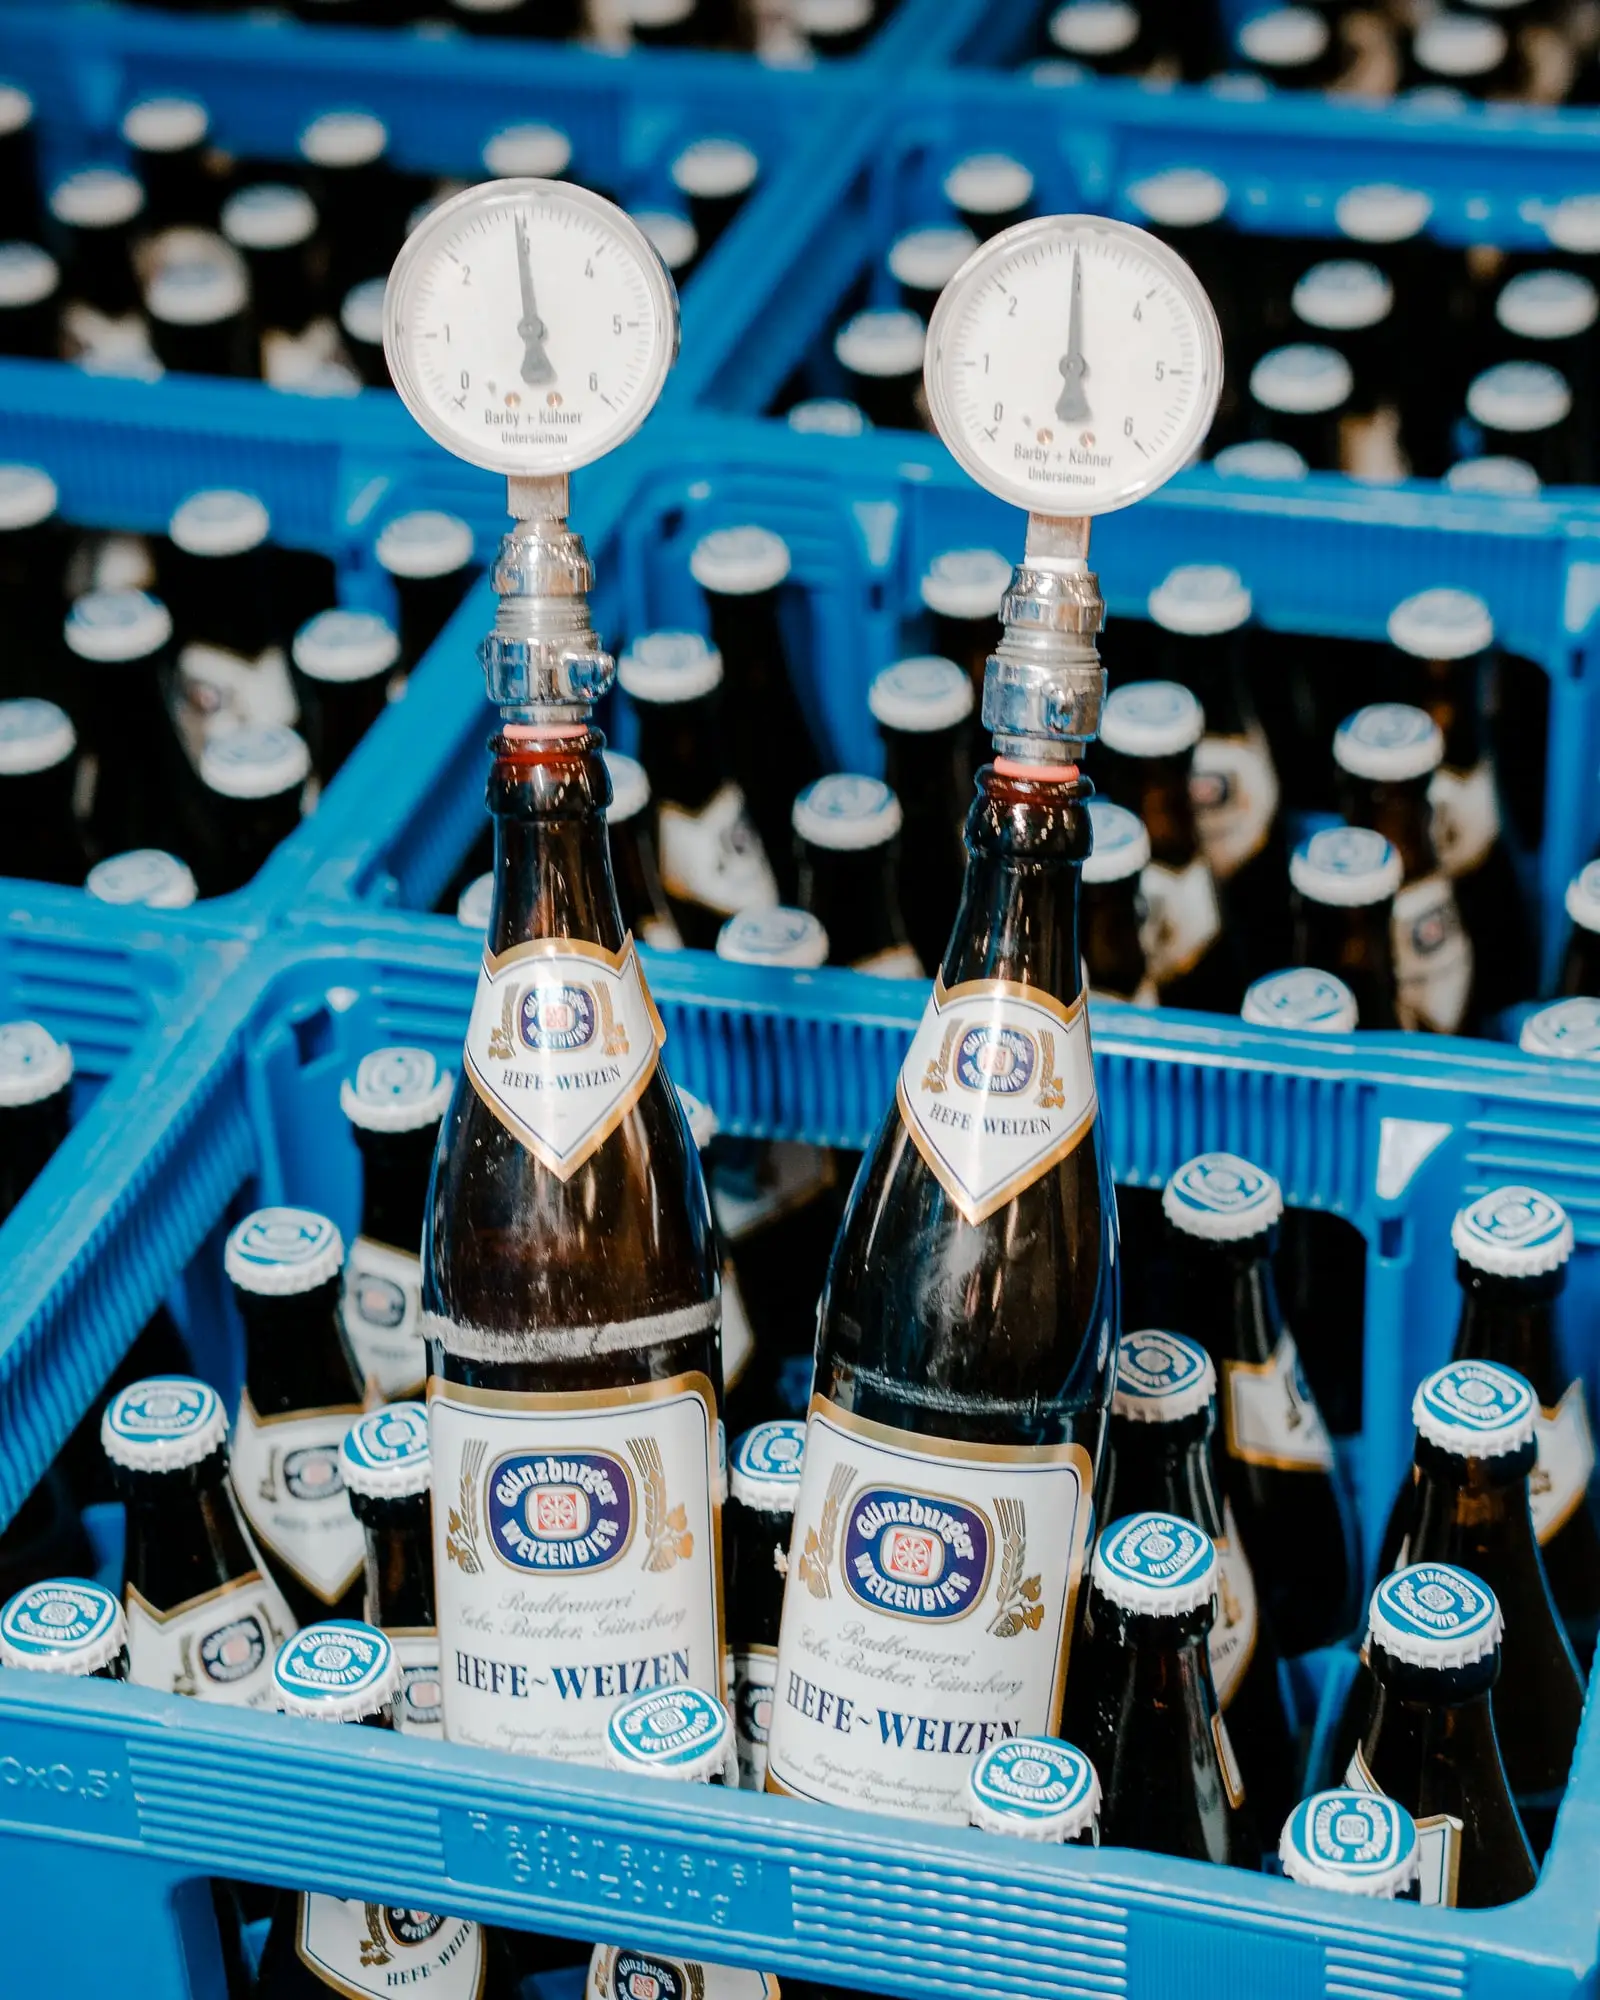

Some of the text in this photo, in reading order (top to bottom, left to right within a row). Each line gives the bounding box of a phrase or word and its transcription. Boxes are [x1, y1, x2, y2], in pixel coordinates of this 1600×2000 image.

[461, 265, 472, 286] 2
[584, 258, 595, 280] 4
[1007, 295, 1019, 317] 2
[1132, 302, 1143, 323] 4
[443, 323, 451, 344] 1
[612, 314, 623, 336] 5
[983, 352, 991, 374] 1
[1154, 361, 1166, 383] 5
[460, 370, 471, 391] 0
[588, 371, 599, 393] 6
[993, 400, 1005, 423] 0
[1123, 416, 1135, 438] 6
[501, 1518, 619, 1565] WEIZENBIER
[852, 1550, 972, 1612] WEIZENBIER
